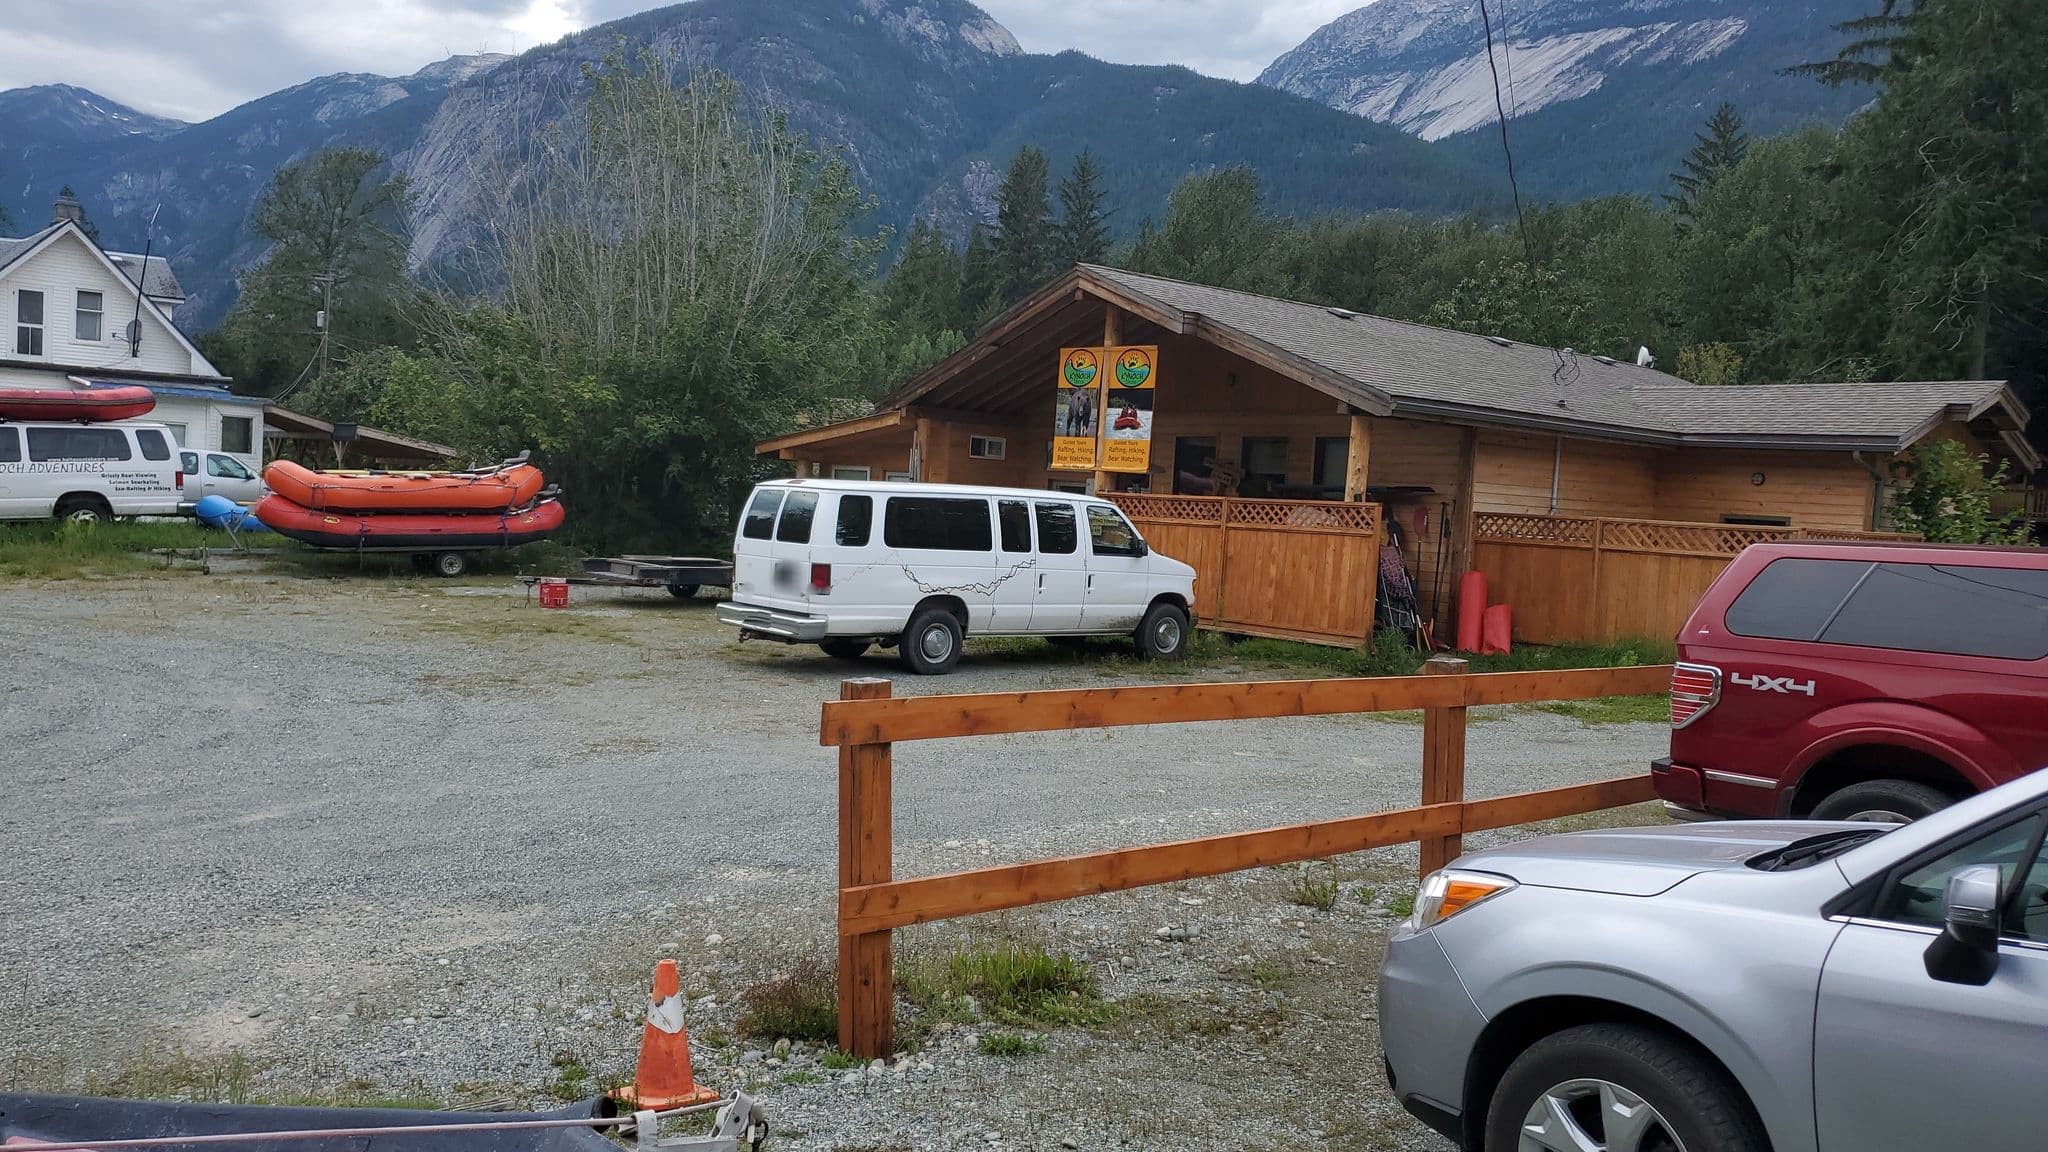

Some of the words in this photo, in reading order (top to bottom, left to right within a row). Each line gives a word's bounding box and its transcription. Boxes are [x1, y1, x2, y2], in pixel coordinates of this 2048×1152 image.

[1057, 454, 1068, 462] Bear
[1069, 454, 1092, 463] Watching
[1107, 454, 1119, 463] Bear
[1120, 455, 1144, 464] Watching
[29, 463, 105, 473] ADVENTURES
